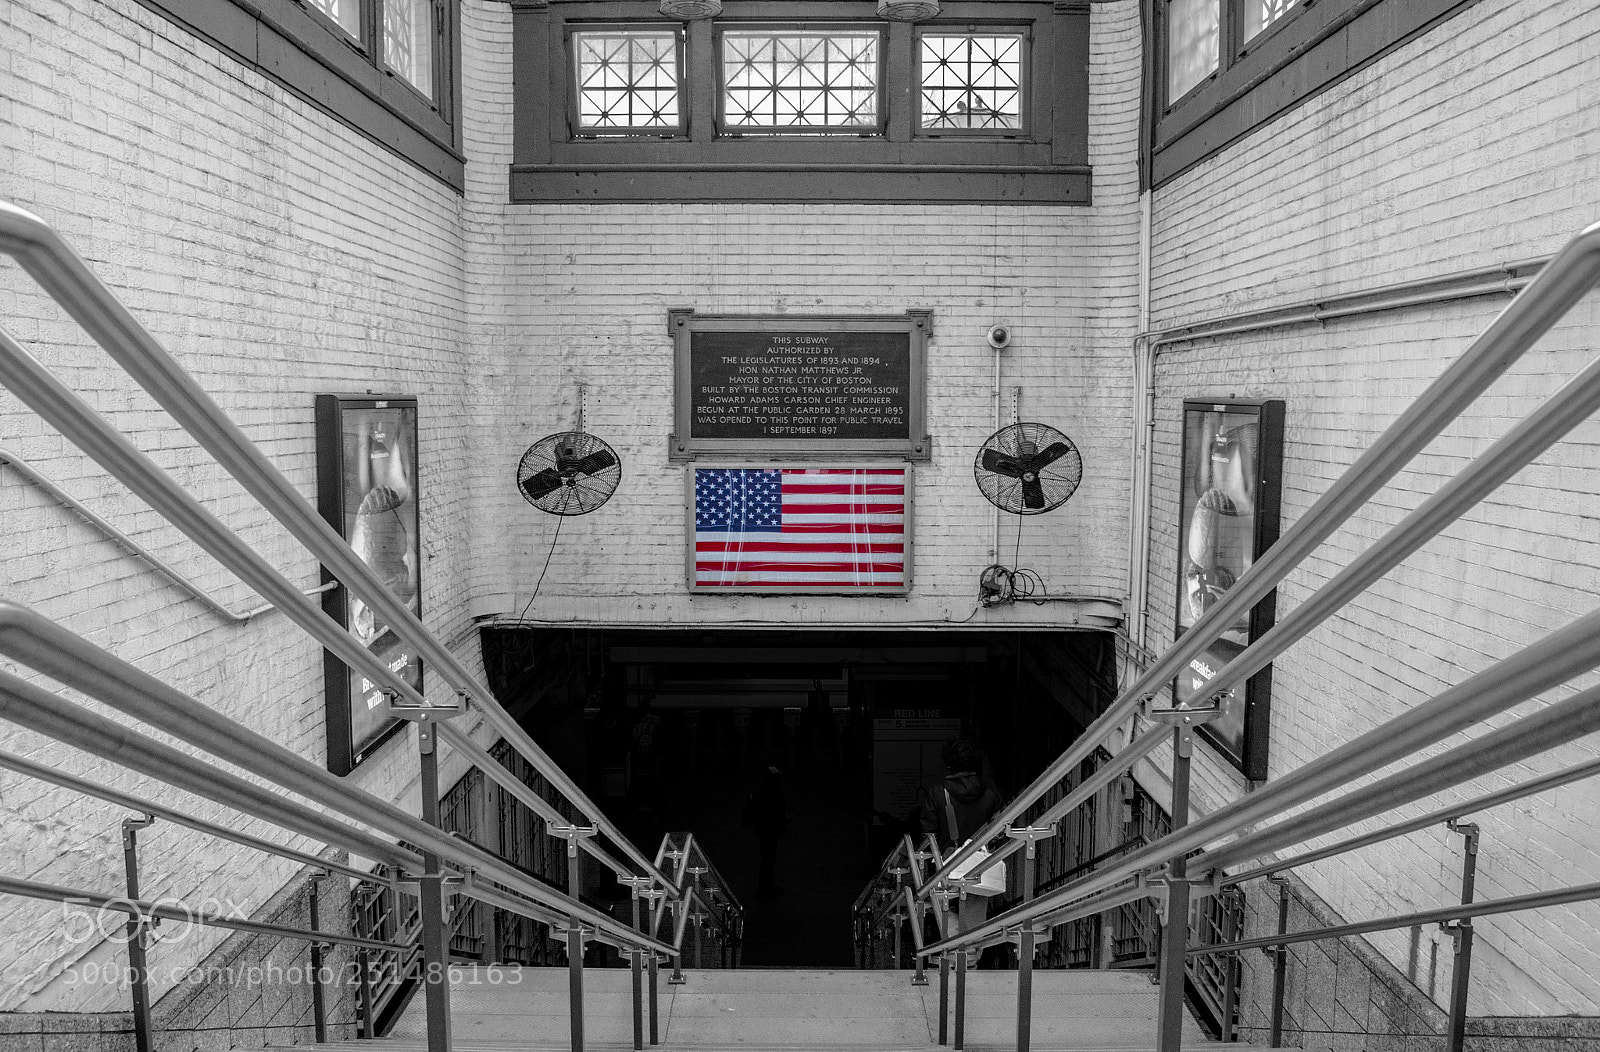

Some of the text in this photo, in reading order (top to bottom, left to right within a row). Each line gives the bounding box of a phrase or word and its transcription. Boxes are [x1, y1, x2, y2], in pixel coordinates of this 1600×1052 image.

[773, 336, 829, 344] THIS SUBWAY
[766, 346, 835, 354] AUTHORIZED BY
[721, 356, 880, 364] THE LEGISLATURES OF 1893 AND 1894
[739, 366, 863, 374] HON NATHAN MATTHEWS JR
[729, 376, 872, 384] MAYOR OF THE CITY OF BOSTON
[702, 386, 899, 394] BUILT BY THE BOSTON TRANSIT COMMISSION
[709, 396, 891, 404] HOWARD ADAMS CARSON CHIEF ENGINEER
[697, 406, 904, 414] BEGUN AT THE PUBLIC GARDEN 28 MARCH 1895
[697, 416, 903, 424] WAS OPENED TO THIS POINT FOR PUBLIC TRAVEL
[770, 426, 817, 435] SEPTEMBER
[819, 426, 838, 435] 1897
[894, 709, 941, 718] RED LINE
